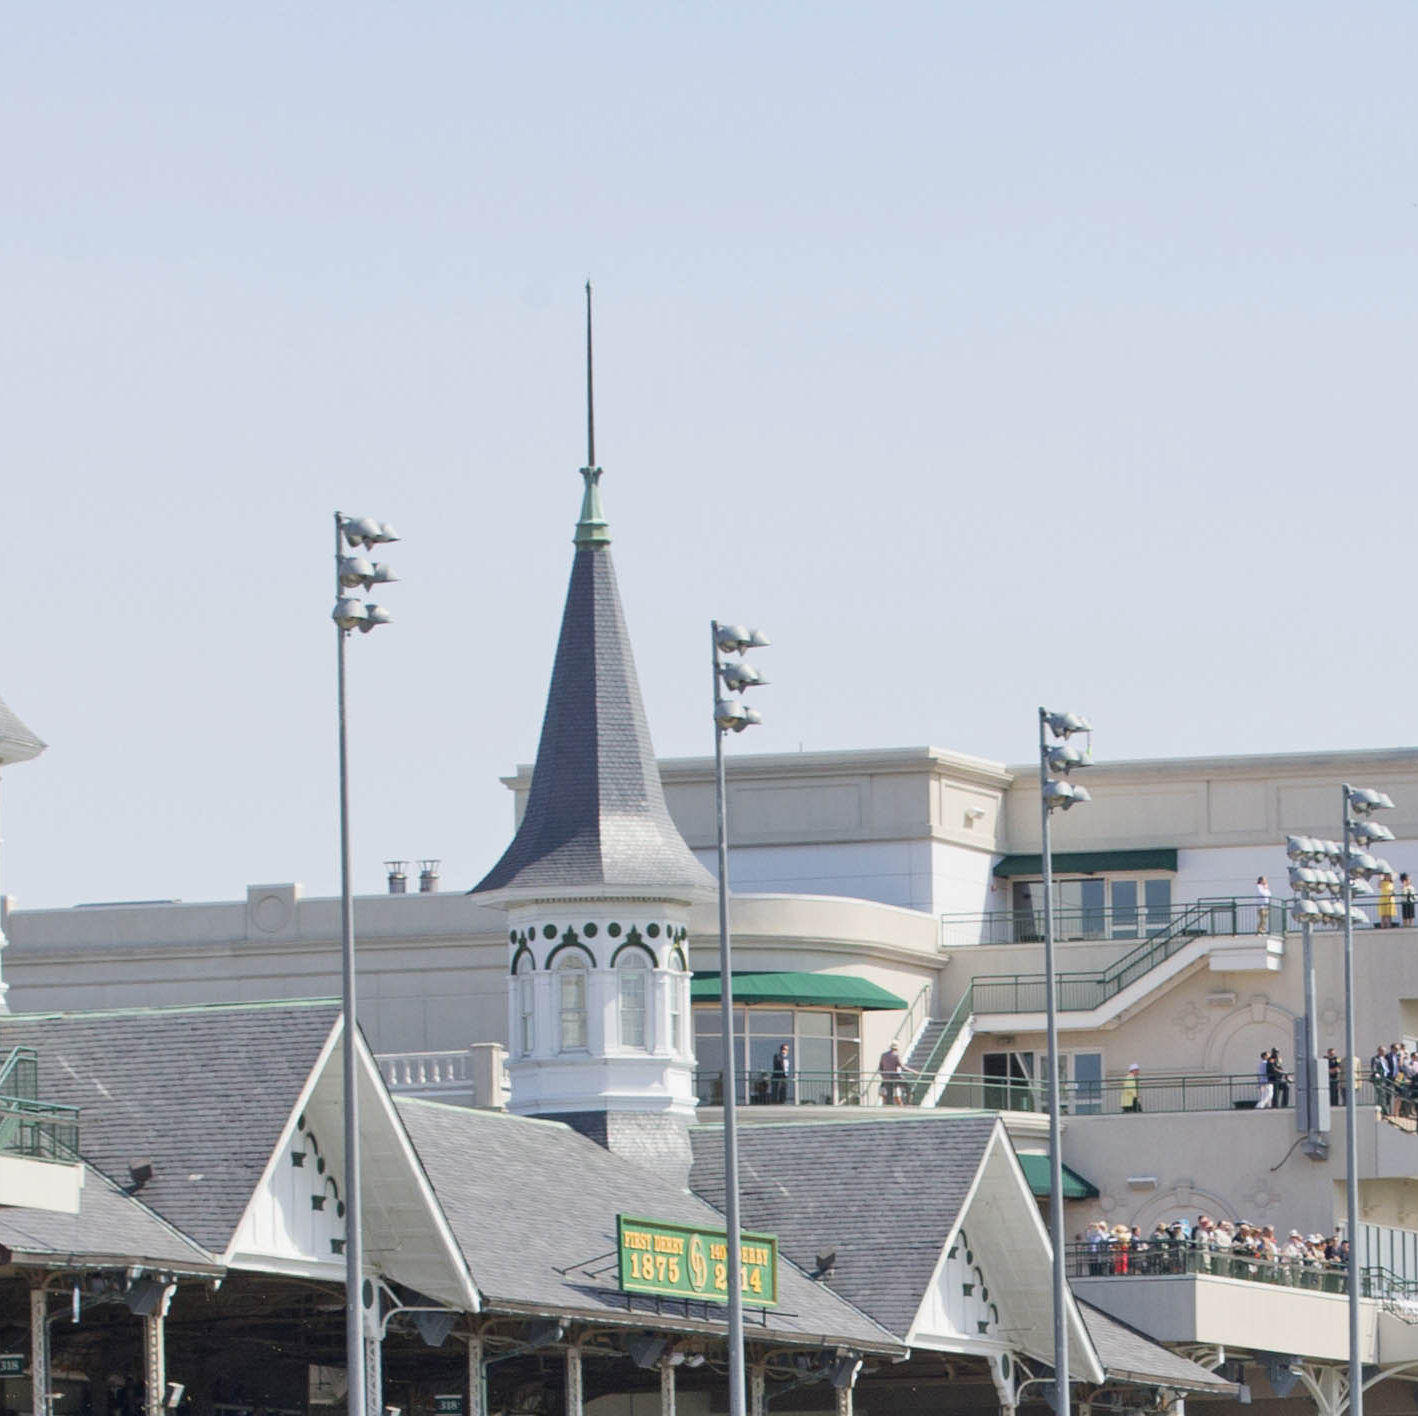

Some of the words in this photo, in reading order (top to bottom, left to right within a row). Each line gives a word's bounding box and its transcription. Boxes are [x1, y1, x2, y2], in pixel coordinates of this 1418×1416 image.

[624, 1231, 652, 1250] FIRST
[653, 1235, 684, 1255] DERBY
[630, 1254, 680, 1283] 1875
[714, 1264, 762, 1293] 214
